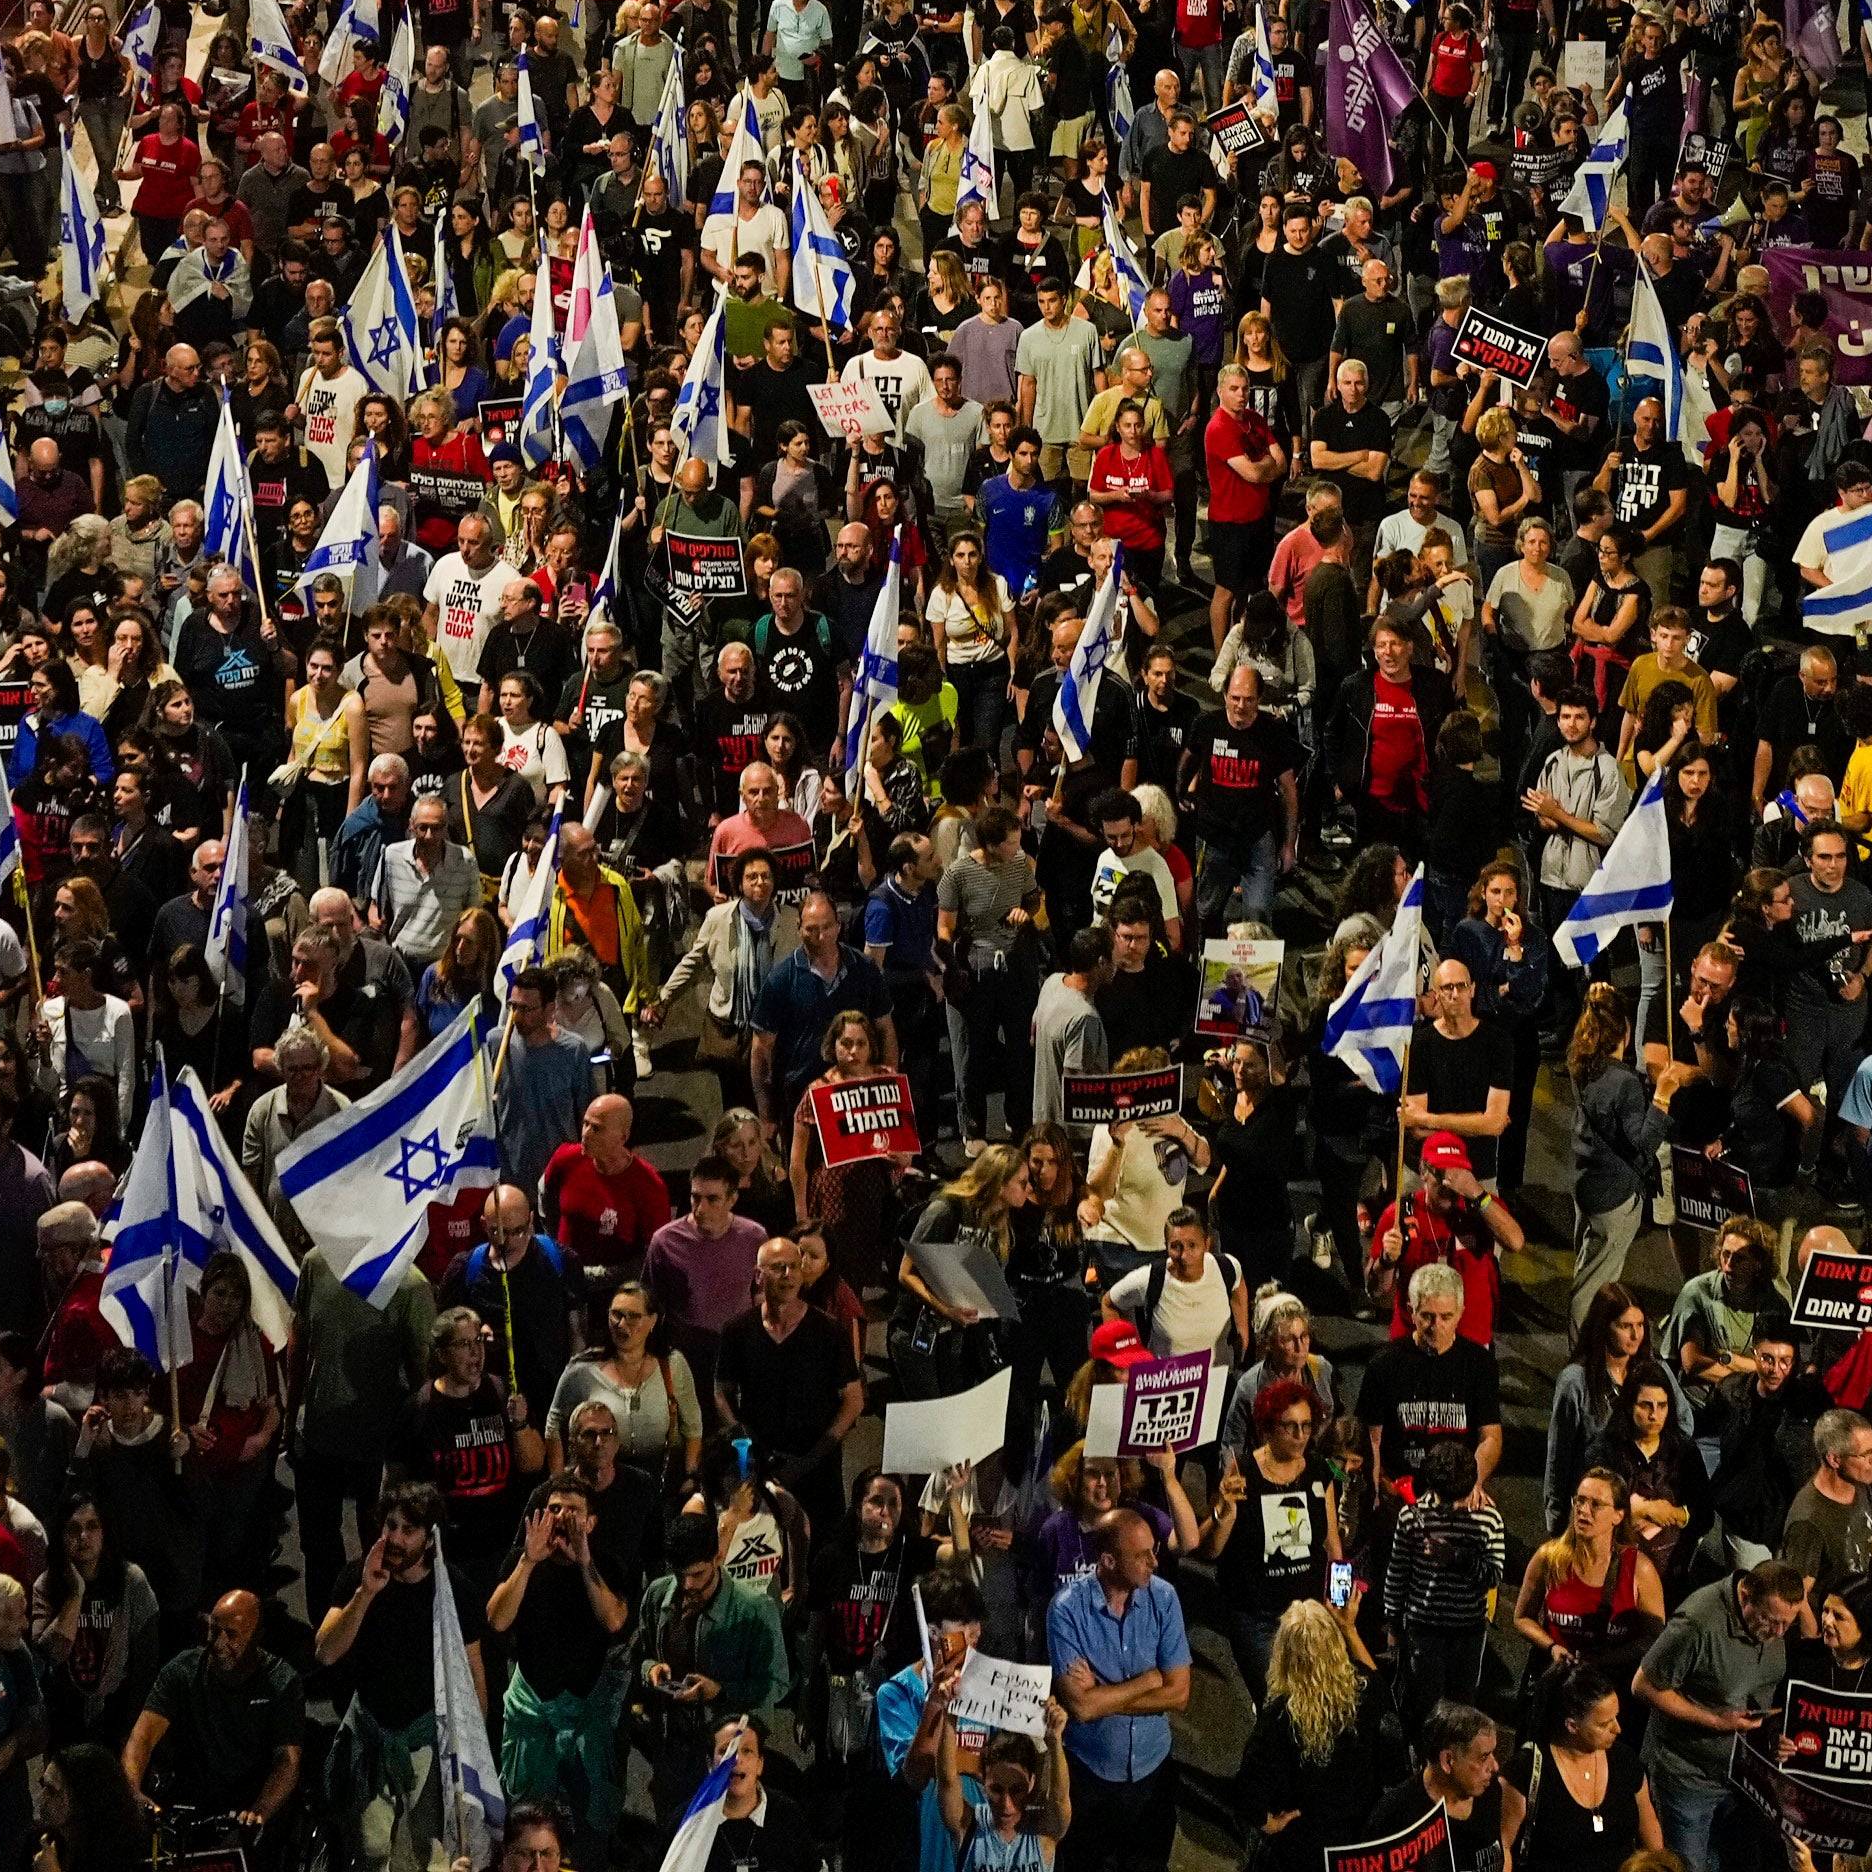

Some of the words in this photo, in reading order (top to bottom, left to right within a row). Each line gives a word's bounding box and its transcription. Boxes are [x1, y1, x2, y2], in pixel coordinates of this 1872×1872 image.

[1517, 341, 1538, 360] אל
[813, 386, 842, 402] LET
[844, 382, 862, 398] MY
[822, 400, 871, 418] SISTERS
[307, 428, 336, 446] אשם
[839, 419, 862, 436] GO
[453, 578, 482, 596] אתה
[444, 594, 483, 612] הראש
[446, 607, 476, 624] אתה
[444, 621, 475, 640] אשם
[1210, 755, 1259, 787] NOW!
[1070, 1102, 1116, 1122] אותם
[1119, 1097, 1174, 1116] מצילים
[846, 1106, 900, 1135] הזמן!
[1139, 1393, 1195, 1419] נגד
[1135, 1416, 1193, 1433] ממשלת
[1129, 1427, 1192, 1445] המוות
[1798, 1699, 1855, 1727] ישראל
[1826, 1727, 1855, 1746] את
